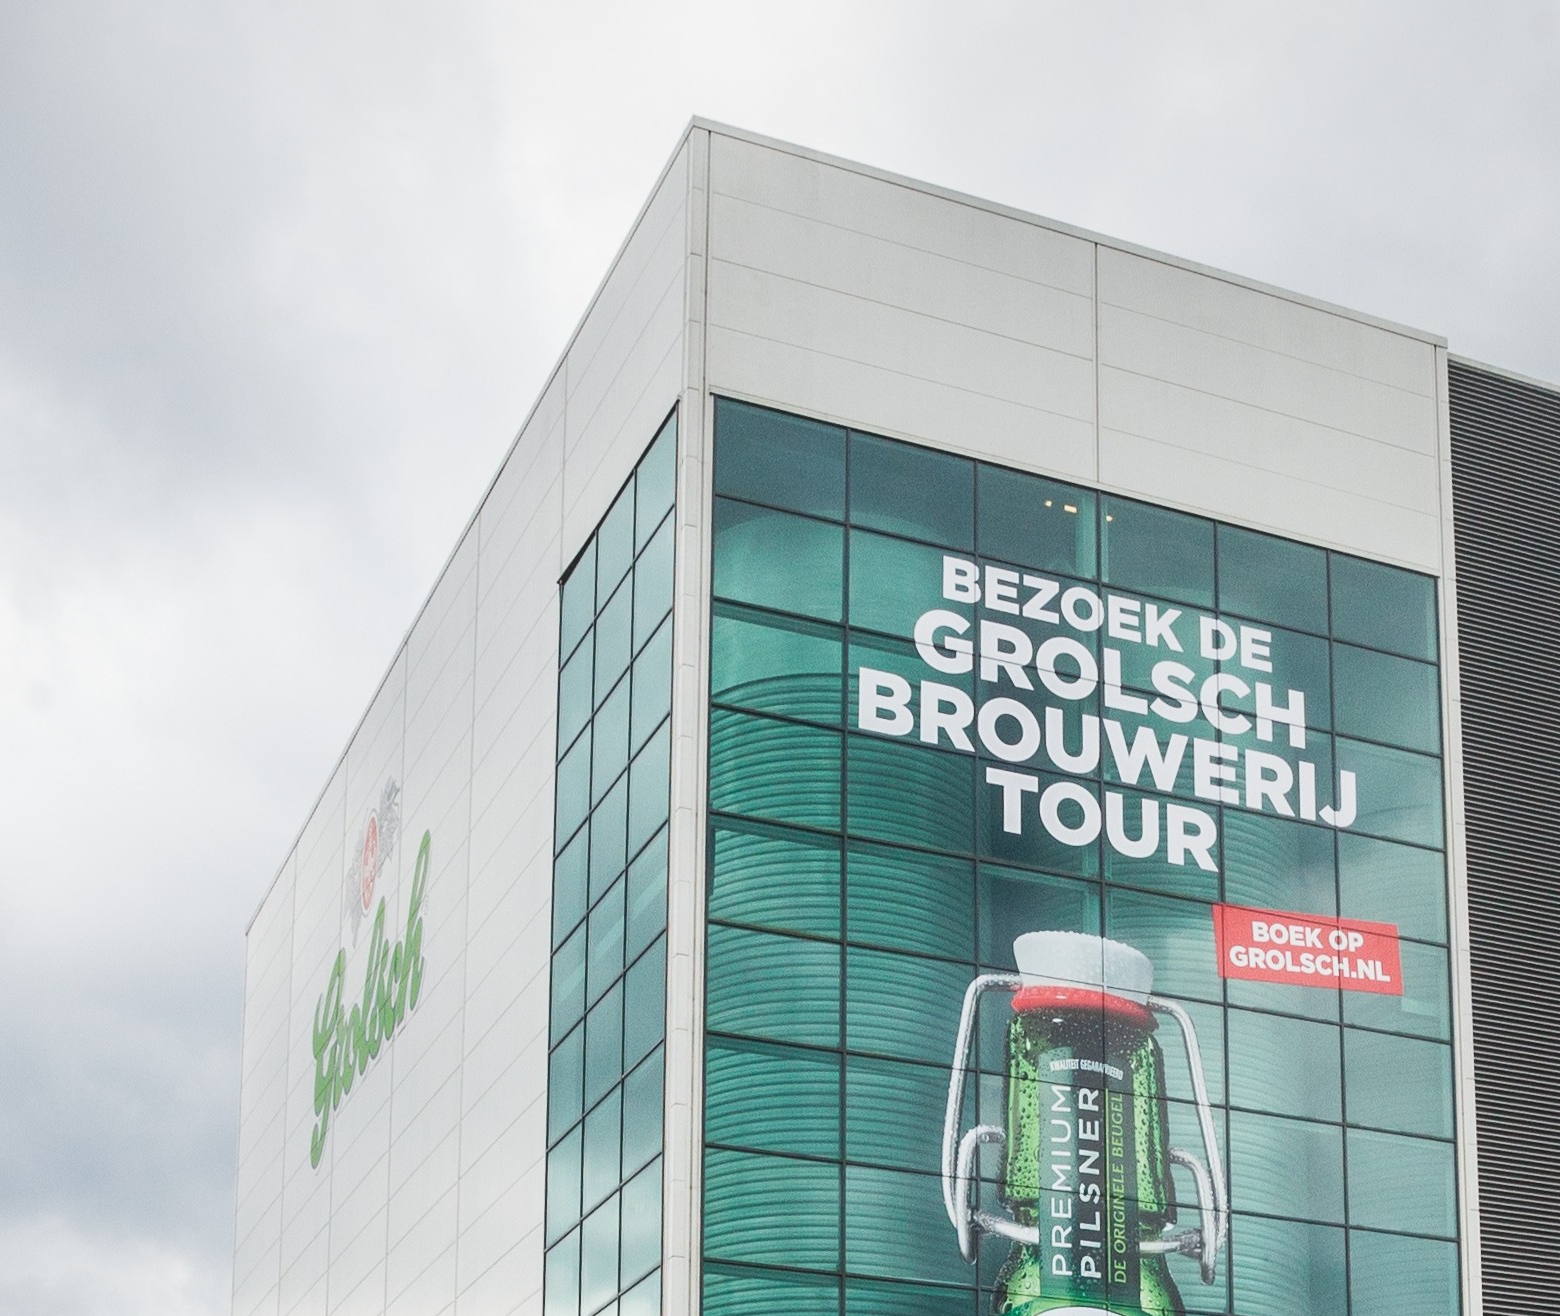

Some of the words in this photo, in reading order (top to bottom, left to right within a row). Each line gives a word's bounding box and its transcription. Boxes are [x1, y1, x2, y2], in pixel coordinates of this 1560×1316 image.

[942, 555, 1183, 653] BEZOEK
[1199, 614, 1273, 672] DE
[913, 609, 1306, 749] GROLSCH
[858, 667, 1357, 828] BROUWERIJ
[986, 767, 1219, 872] TOUR
[1229, 945, 1391, 982] GROLSCH.NL
[1251, 921, 1323, 950] BOEK
[1329, 927, 1363, 952] OP
[310, 829, 431, 1170] Grolsch
[1051, 1085, 1072, 1276] PREMIUM
[1110, 1094, 1123, 1158] BEUGEL
[1079, 1088, 1102, 1279] PILSNER
[1112, 1163, 1125, 1257] ORIGINELE
[1114, 1261, 1127, 1283] DE
